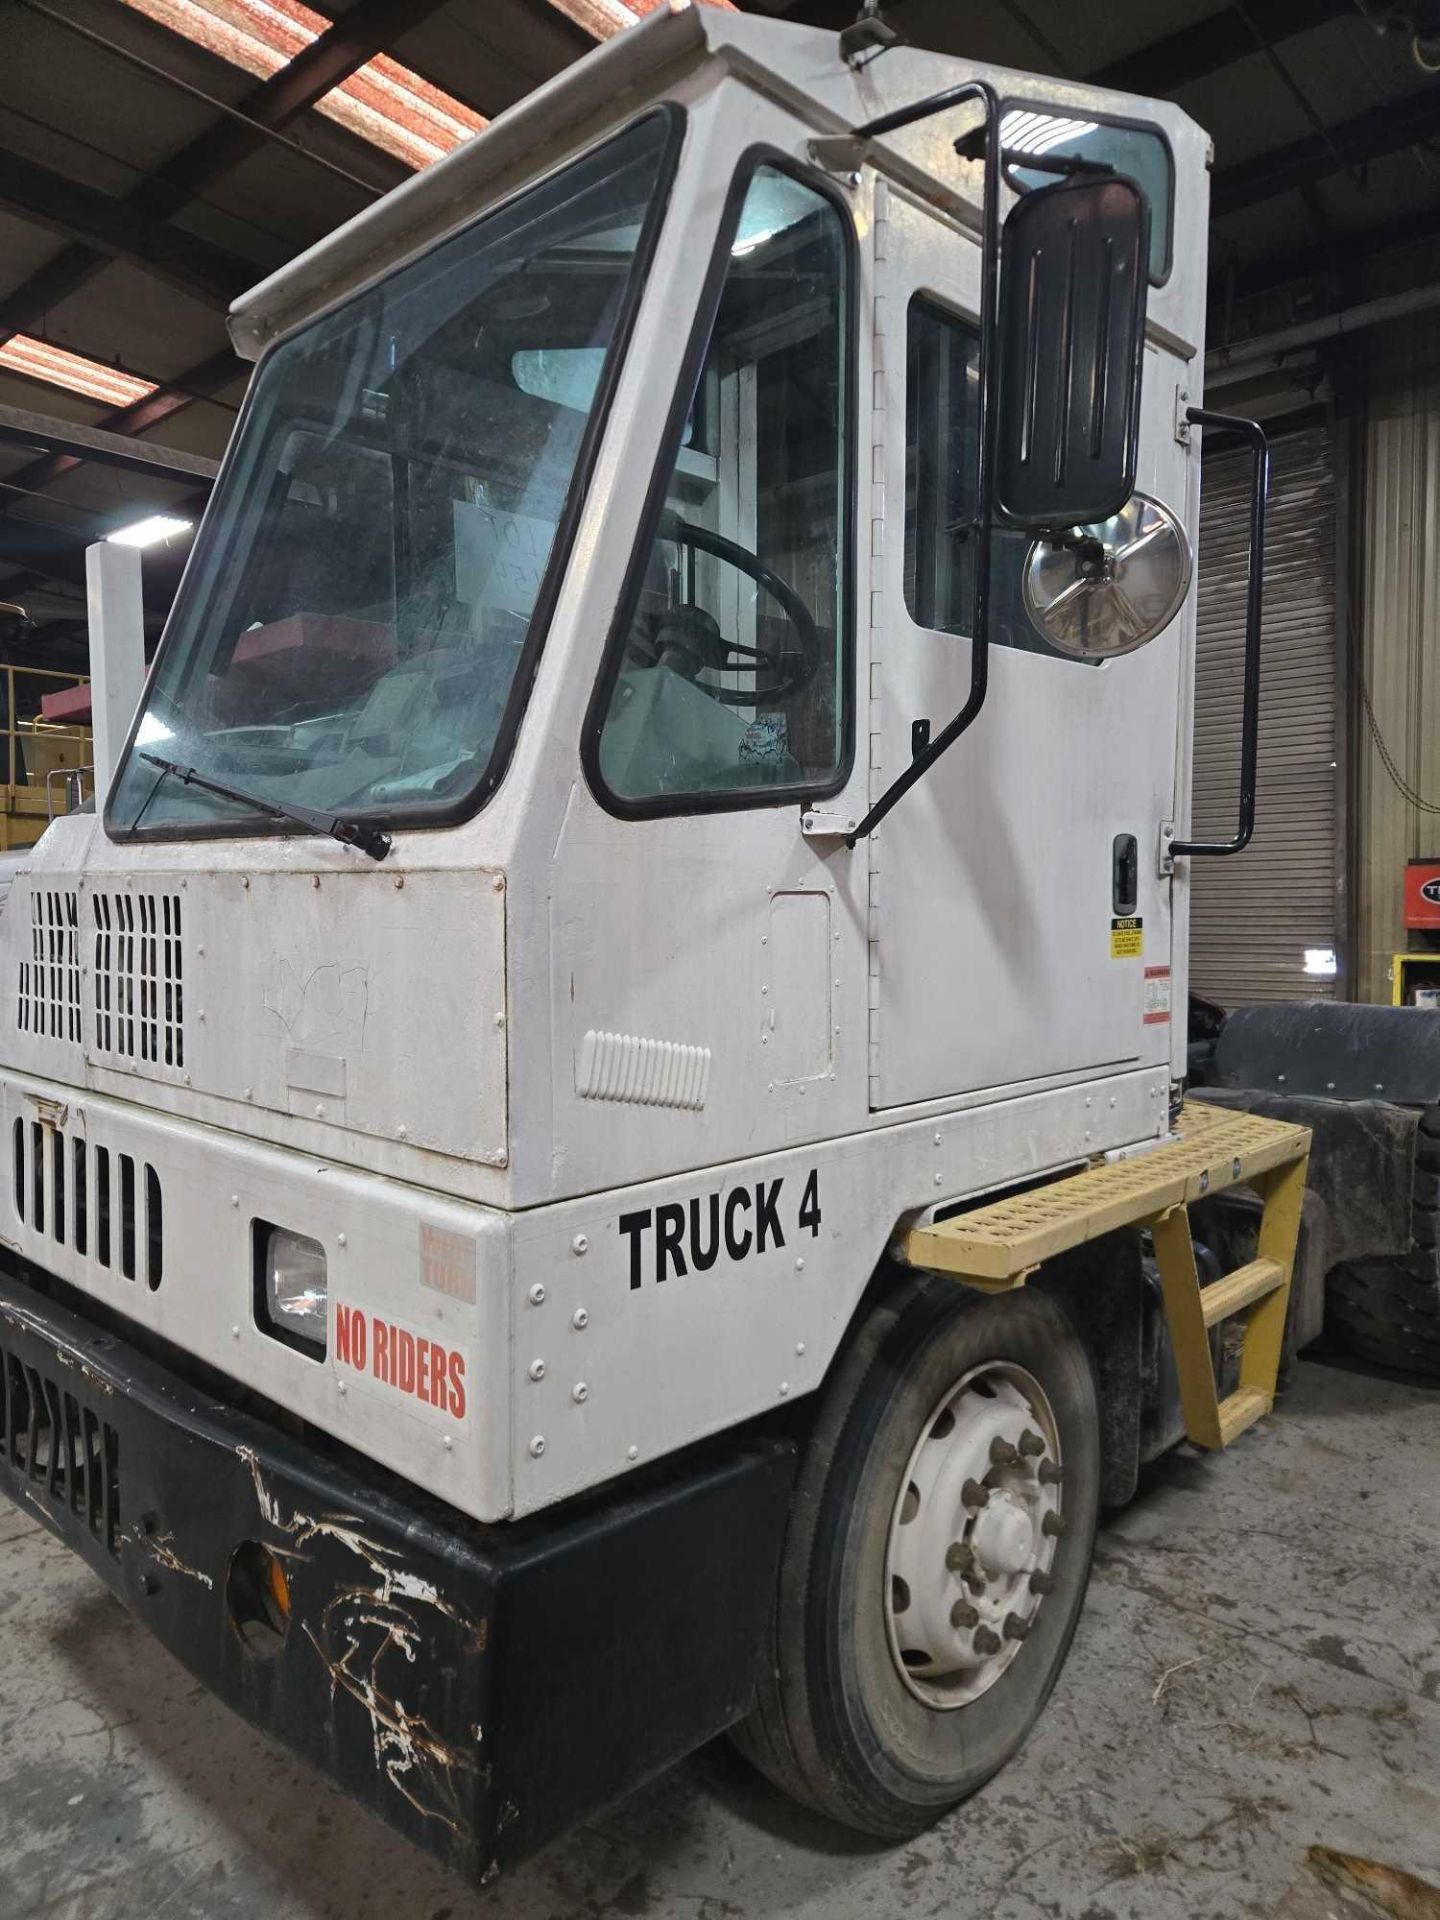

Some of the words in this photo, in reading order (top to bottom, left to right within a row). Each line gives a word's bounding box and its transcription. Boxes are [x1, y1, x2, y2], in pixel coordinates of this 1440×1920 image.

[1116, 919, 1137, 929] NOTICE
[619, 1177, 785, 1290] TRUCK
[799, 1168, 821, 1237] 4
[336, 1303, 366, 1371] NO
[373, 1318, 466, 1419] RIDERS
